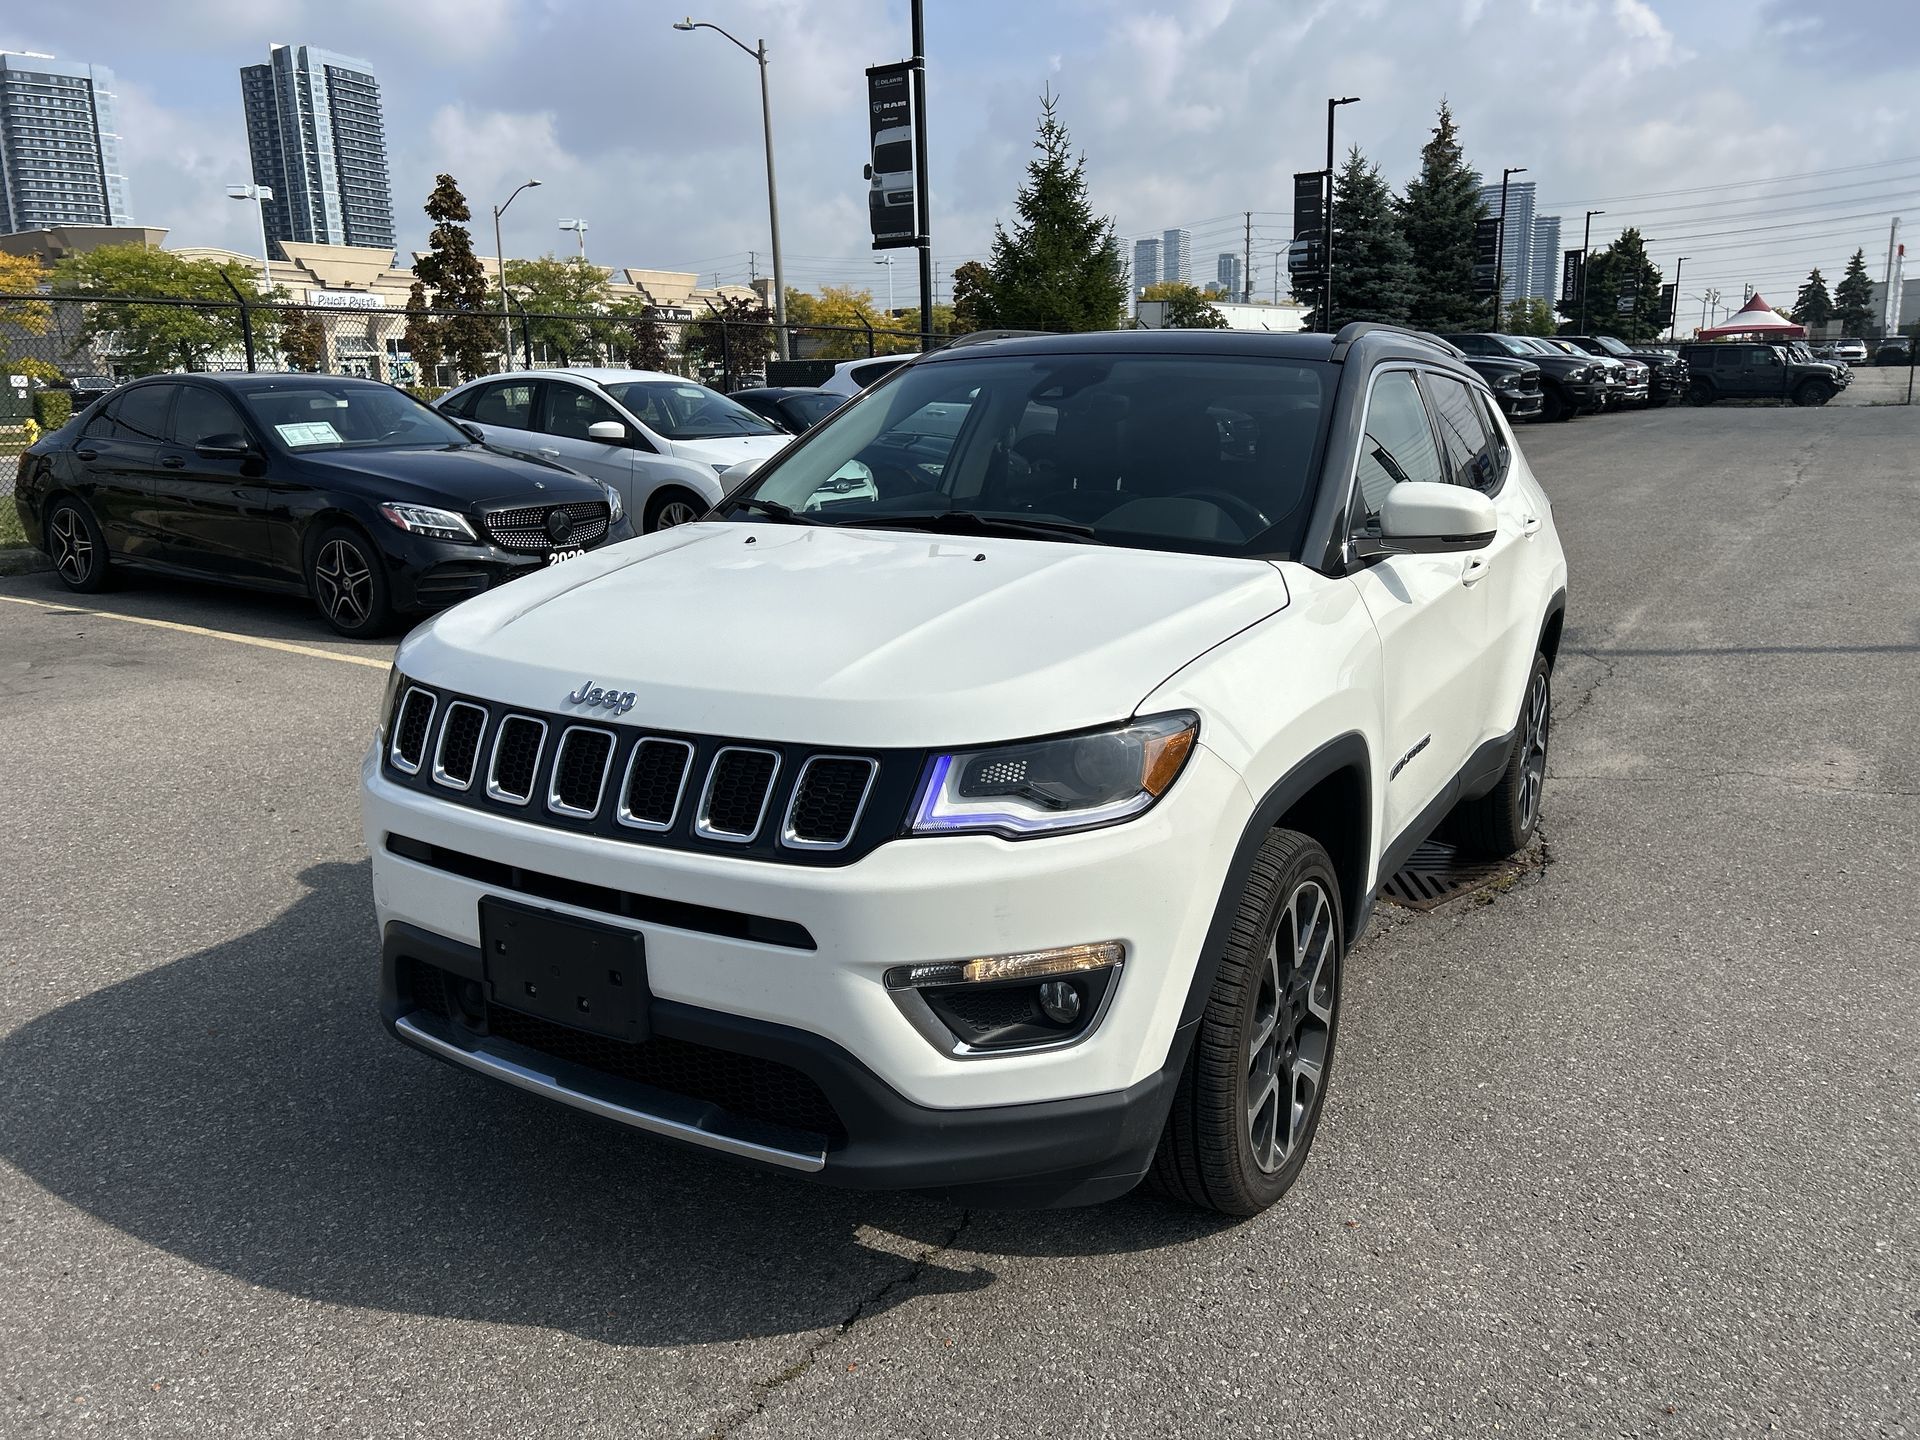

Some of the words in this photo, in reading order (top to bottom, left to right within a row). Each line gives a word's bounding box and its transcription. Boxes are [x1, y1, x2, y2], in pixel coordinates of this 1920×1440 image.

[883, 101, 907, 109] RAM
[1566, 257, 1575, 292] DILAWRI
[569, 679, 638, 716] Jeep
